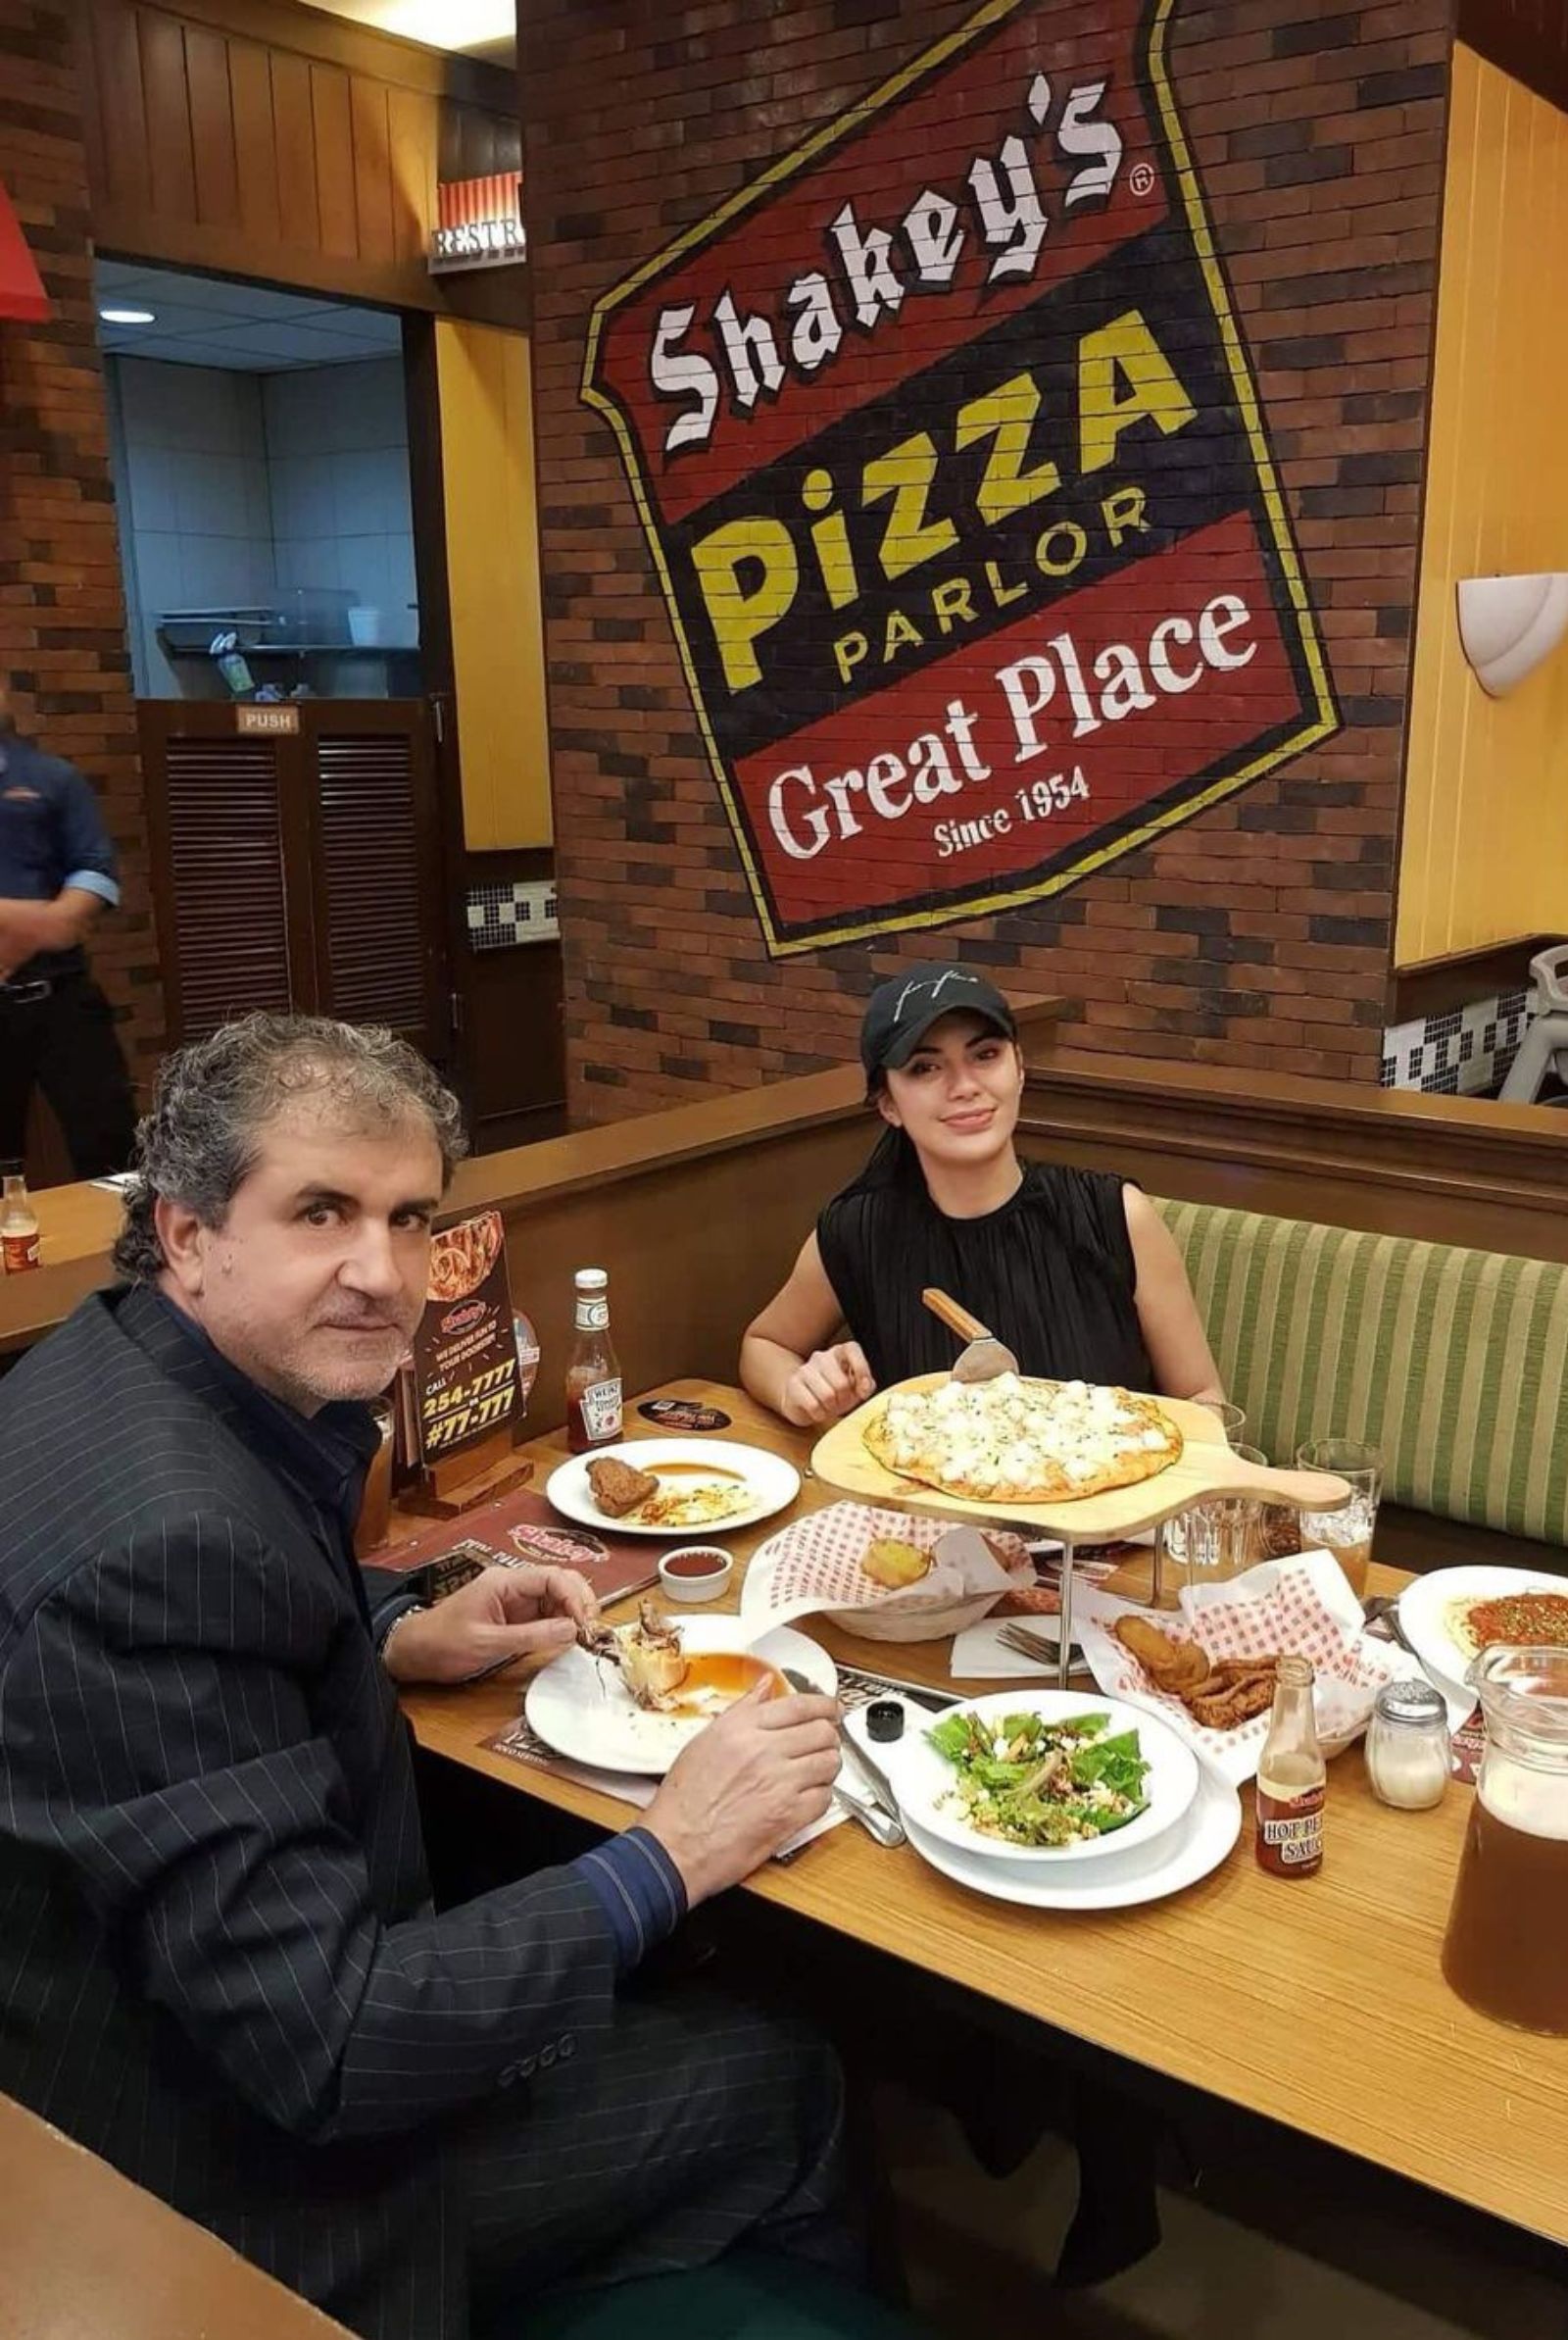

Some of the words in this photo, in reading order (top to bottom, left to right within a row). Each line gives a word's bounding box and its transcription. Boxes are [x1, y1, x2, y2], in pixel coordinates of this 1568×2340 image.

[431, 219, 523, 257] RESTR
[651, 71, 1124, 453] Shakey's
[833, 486, 1152, 684] PARLOR
[245, 713, 292, 728] PUSH
[767, 698, 992, 861] Great
[996, 593, 1258, 763] Place
[933, 806, 1013, 859] Since
[1017, 765, 1091, 822] 1954
[422, 1358, 516, 1420] 254-7777
[425, 1376, 447, 1397] CALL
[425, 1384, 516, 1450] #77-777
[1267, 1821, 1298, 1839] HOT
[1286, 1836, 1322, 1859] SAUC
